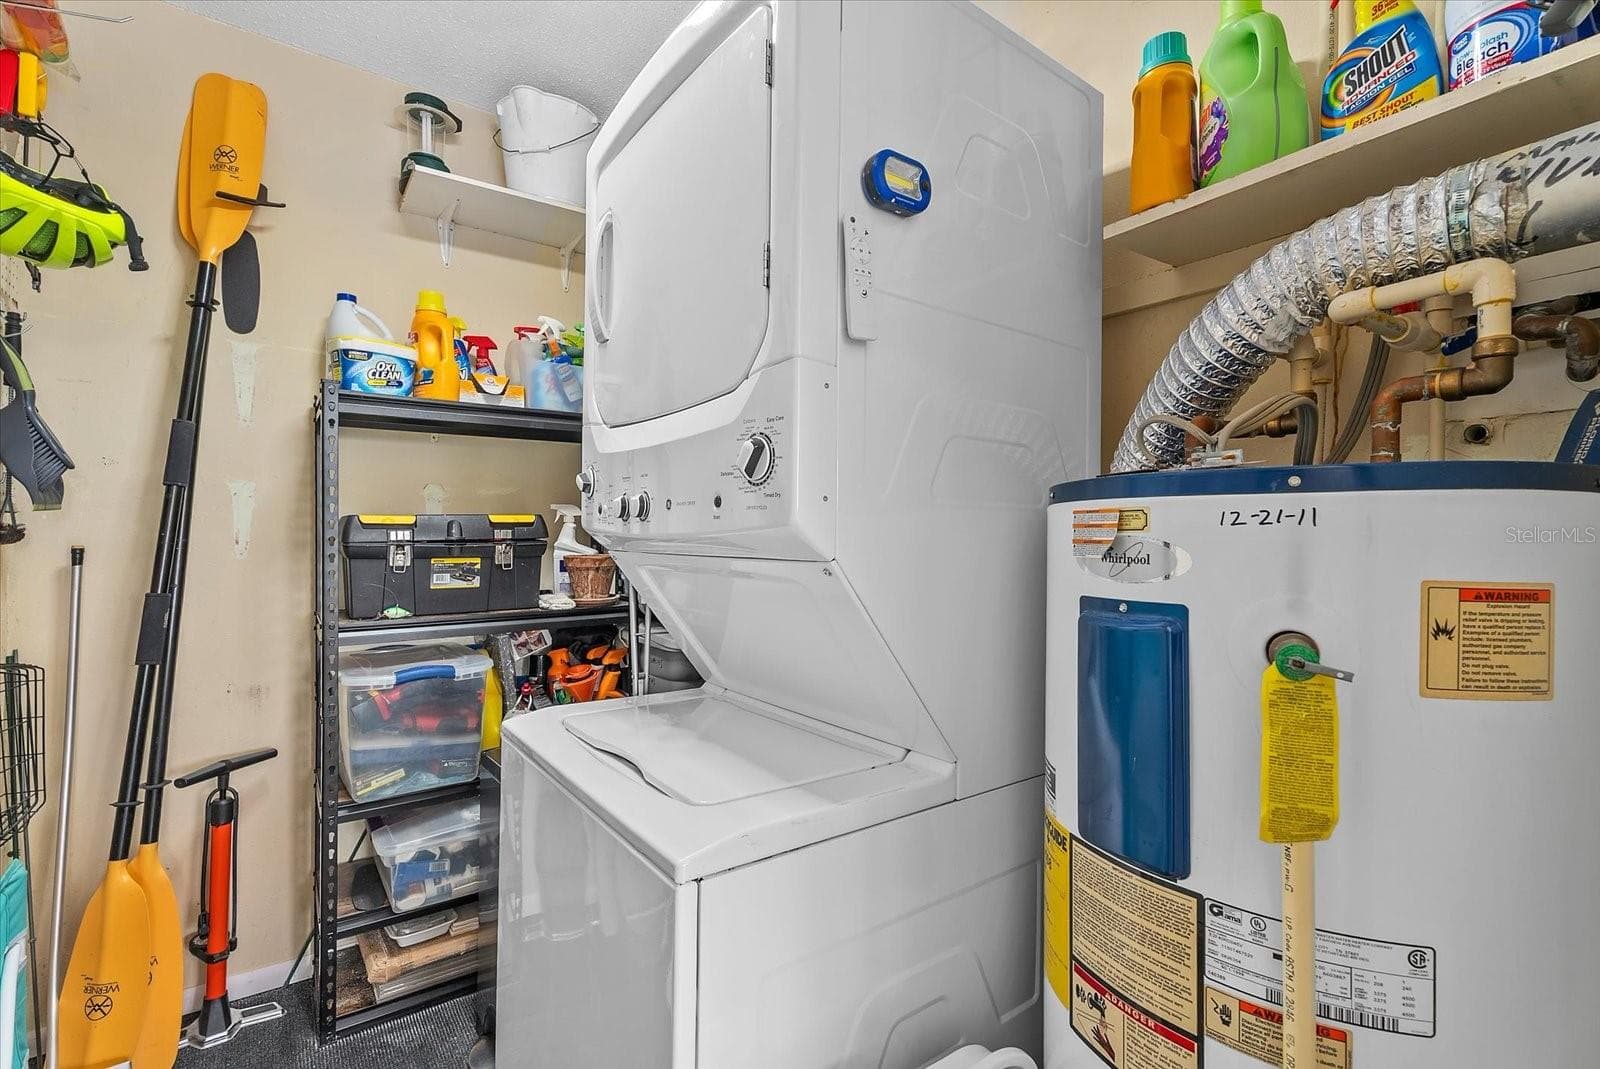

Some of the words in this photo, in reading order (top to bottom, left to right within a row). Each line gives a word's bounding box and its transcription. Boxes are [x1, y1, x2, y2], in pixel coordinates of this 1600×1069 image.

[1372, 1, 1384, 16] 36
[1344, 27, 1409, 97] SHOUT
[1342, 51, 1416, 109] ADVANCED
[1350, 82, 1386, 110] ACTION
[1389, 65, 1413, 85] GEL
[1352, 109, 1379, 130] BEST
[1379, 92, 1414, 115] SHOUT
[209, 164, 240, 173] WERNER
[367, 369, 402, 381] CLEAN
[376, 361, 397, 373] OXI
[1484, 592, 1539, 601] WARNING
[1285, 956, 1295, 982] ASTM
[83, 984, 120, 994] WERNER
[1286, 983, 1295, 993] D
[1112, 996, 1156, 1030] DANGER
[1285, 994, 1295, 1022] 2846
